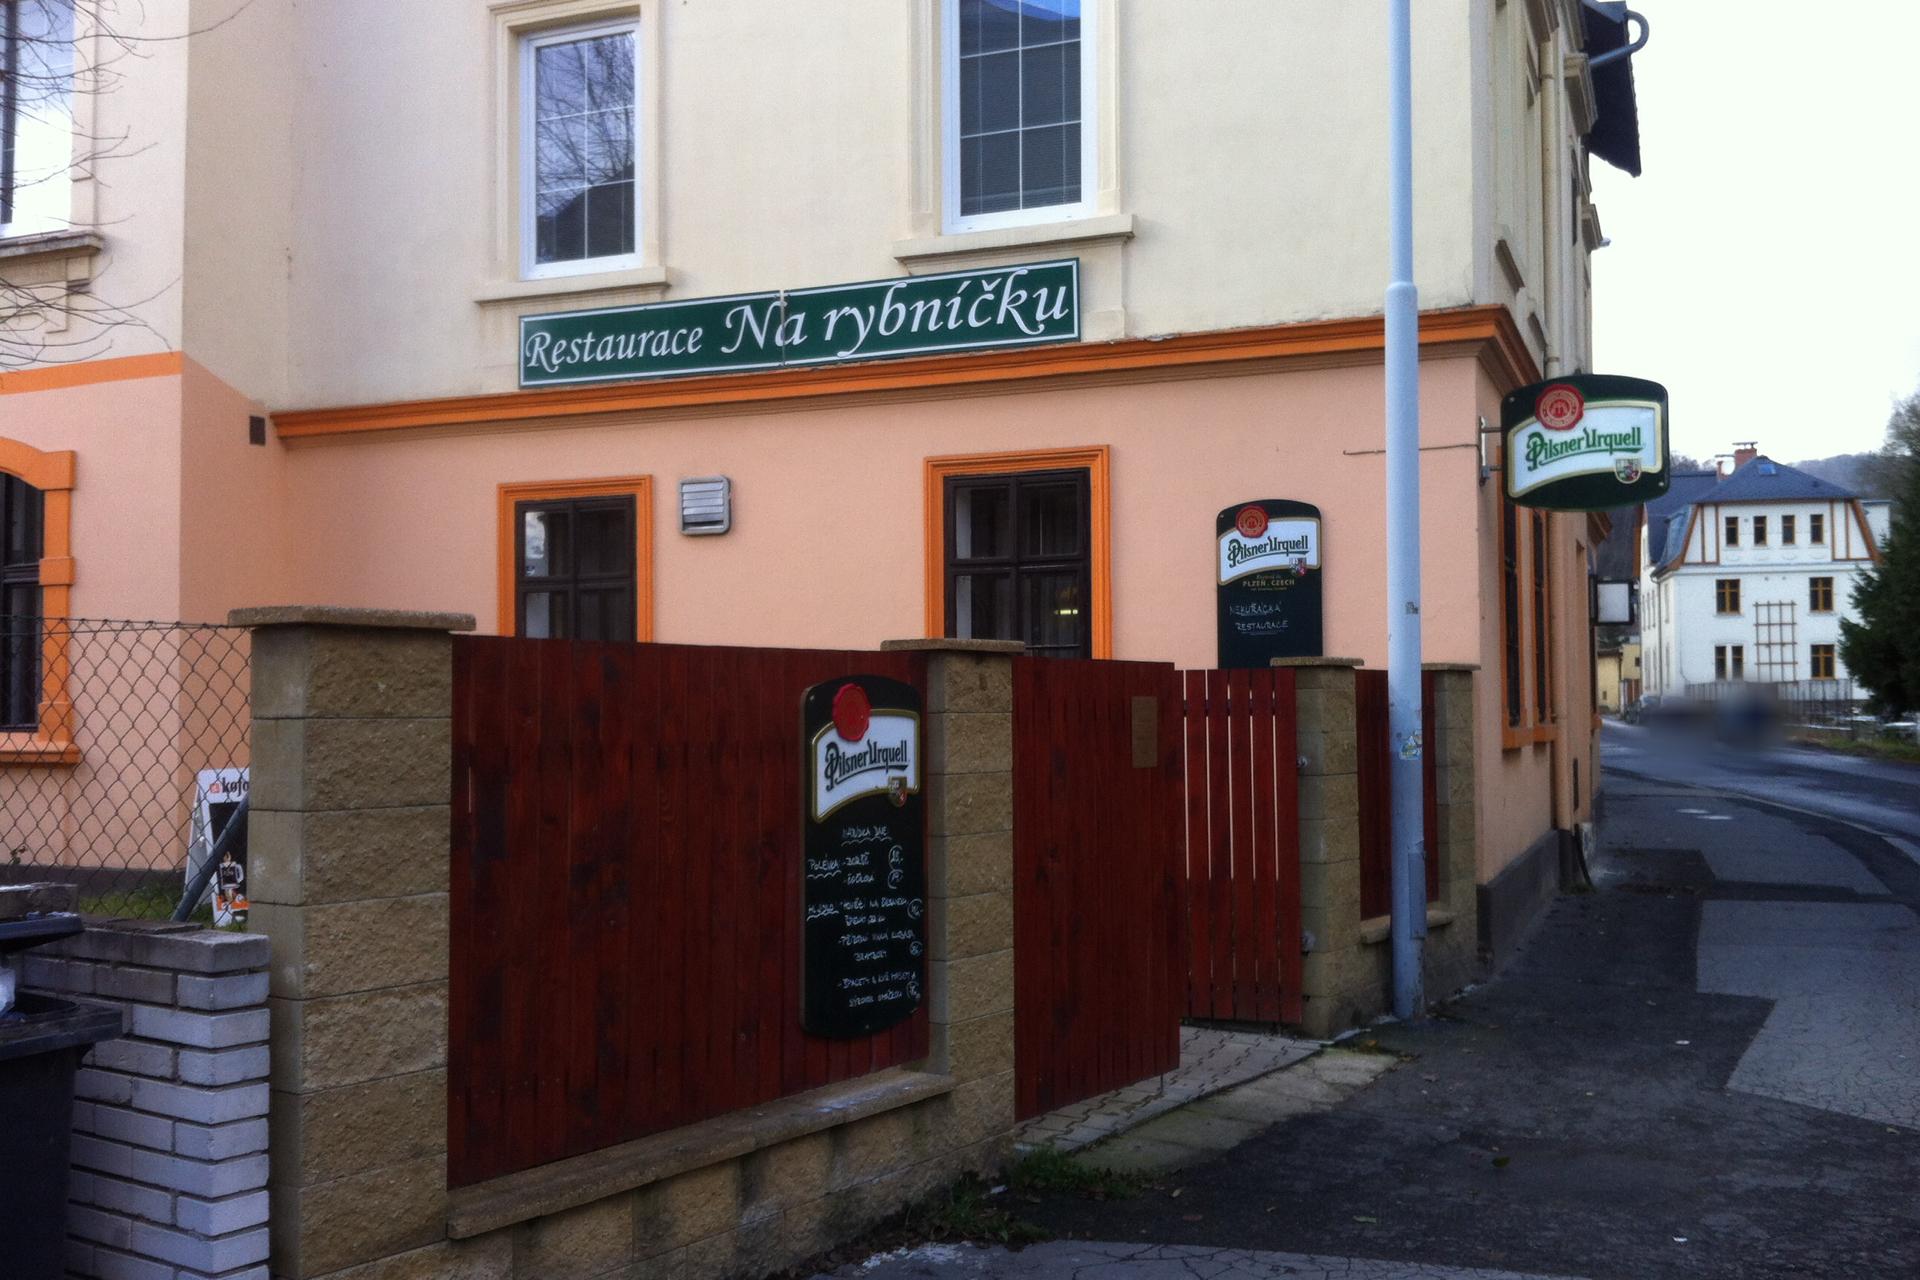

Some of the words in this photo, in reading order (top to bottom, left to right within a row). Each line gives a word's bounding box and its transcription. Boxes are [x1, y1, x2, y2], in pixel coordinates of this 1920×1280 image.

[526, 326, 703, 373] Restaurace
[720, 300, 807, 354] Na
[823, 268, 1069, 358] rybníčku
[1525, 431, 1585, 472] Pilsner
[1583, 426, 1641, 455] Urquell
[1228, 538, 1269, 568] Pilsner
[1268, 535, 1309, 556] Urquell
[824, 741, 867, 792] Pilsner
[867, 738, 908, 773] Urquell
